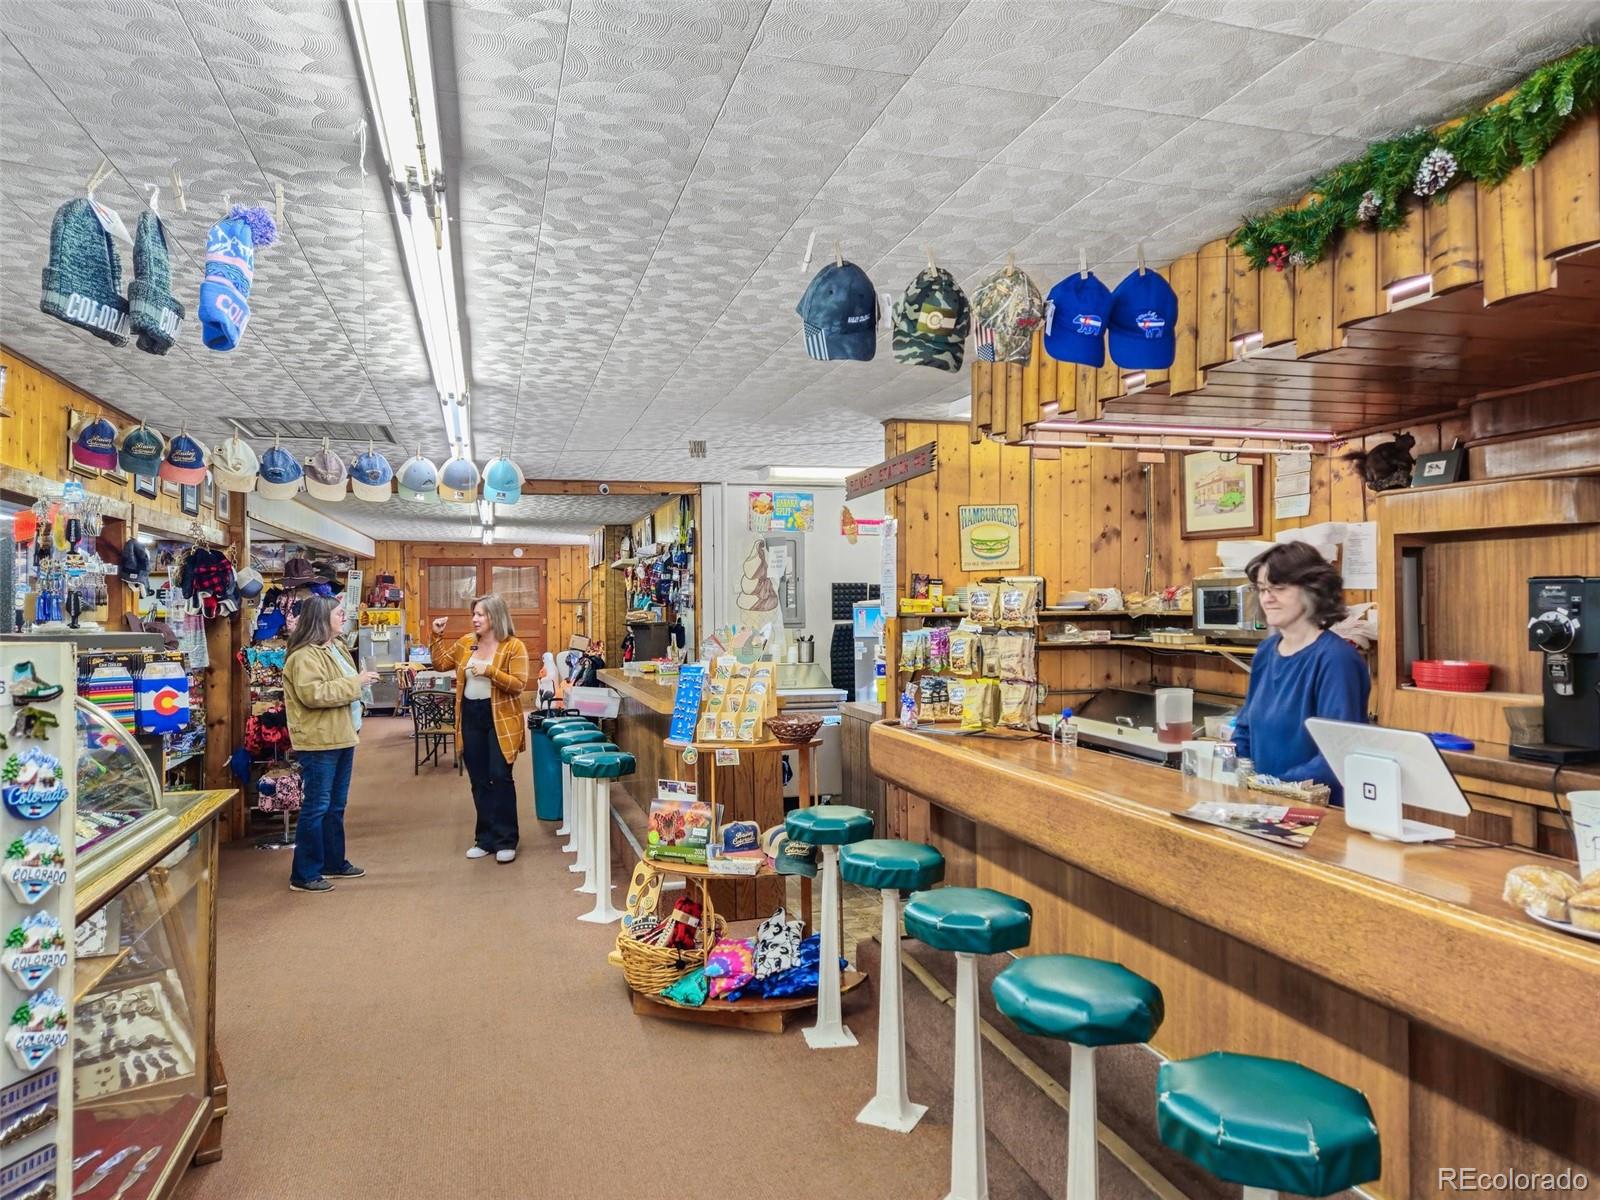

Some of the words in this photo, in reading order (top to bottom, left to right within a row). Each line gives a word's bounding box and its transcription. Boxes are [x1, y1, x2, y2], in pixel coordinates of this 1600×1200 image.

[960, 507, 1018, 530] HAMBURGERS
[8, 785, 69, 806] Colorado
[12, 868, 67, 885] COLORADO
[11, 953, 68, 971] COLORADO
[16, 1033, 69, 1049] COLORADO
[0, 1071, 58, 1107] COLORADO
[0, 1146, 57, 1186] COLORADO
